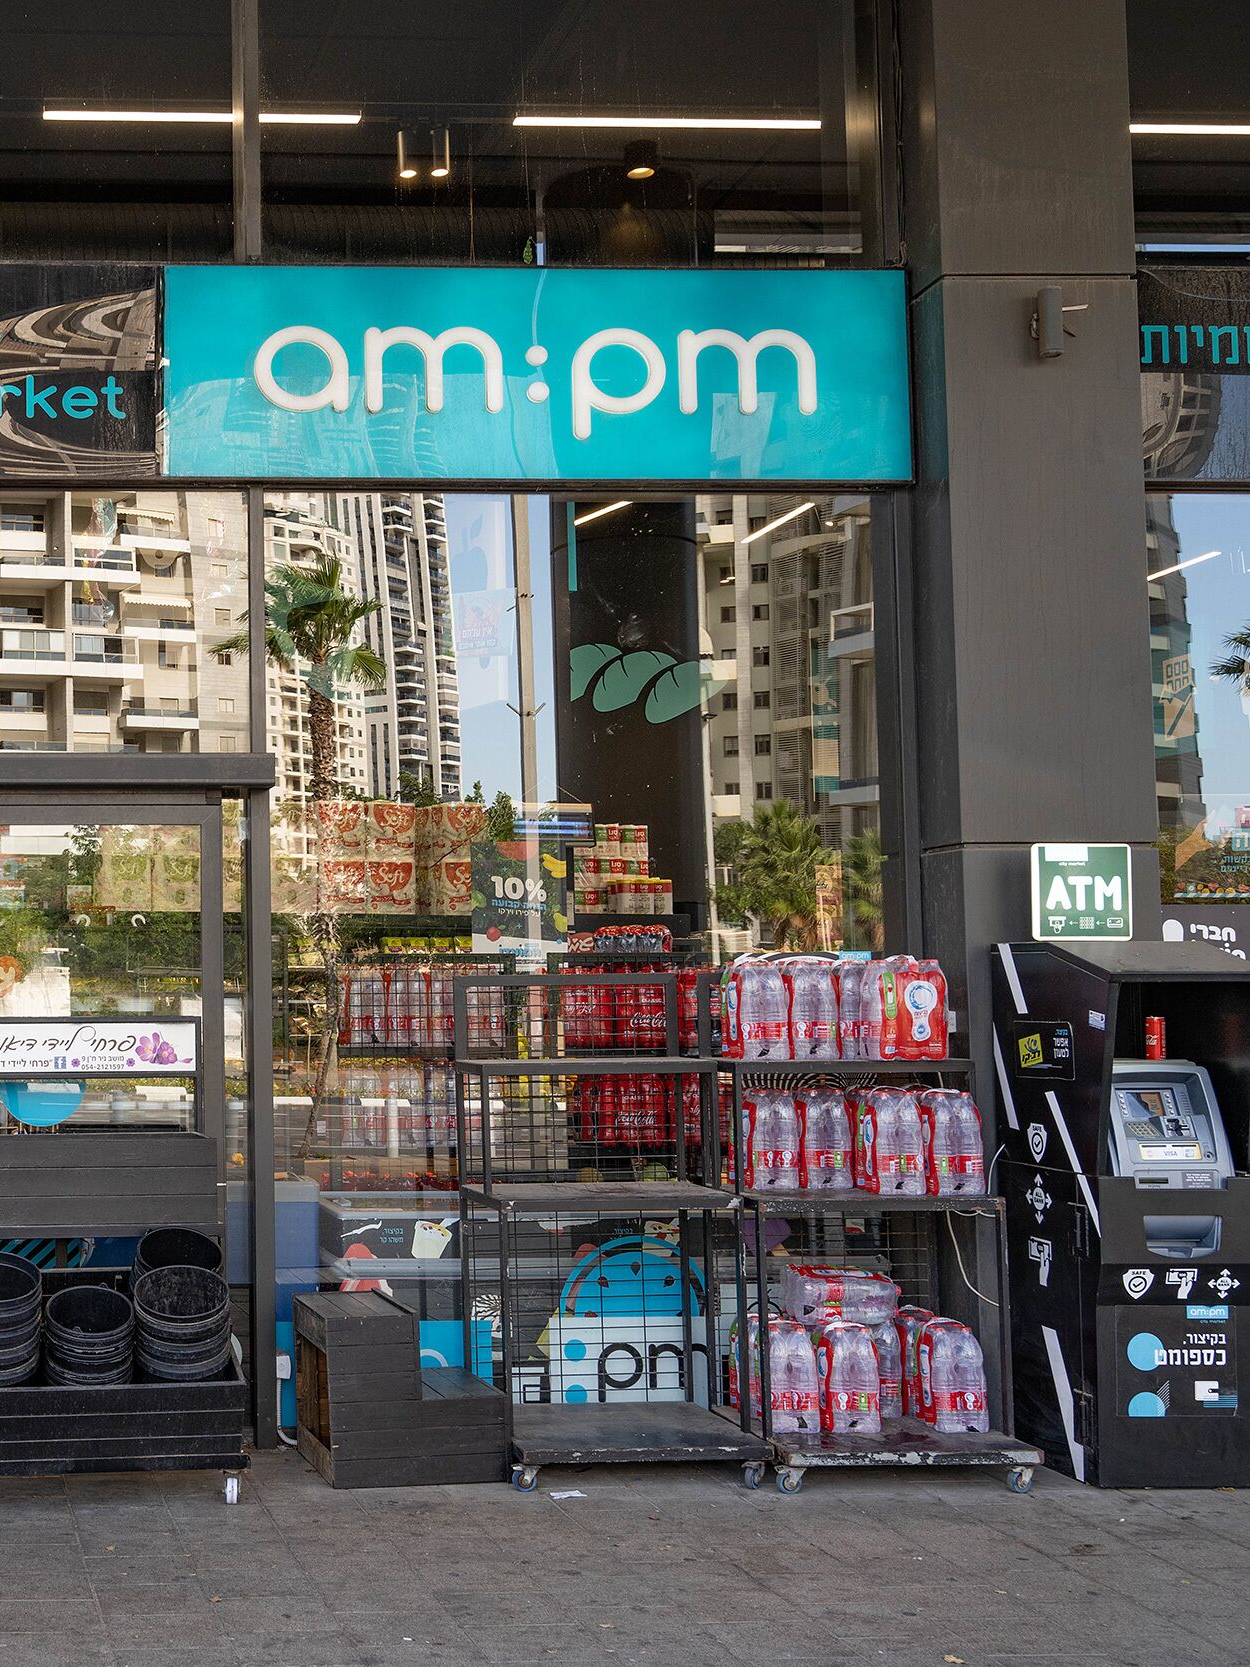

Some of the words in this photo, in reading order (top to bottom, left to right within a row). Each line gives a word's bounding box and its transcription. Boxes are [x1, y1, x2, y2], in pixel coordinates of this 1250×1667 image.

[1141, 325, 1250, 365] מיות
[254, 326, 817, 440] am:pm
[491, 875, 547, 902] 10%
[1046, 875, 1122, 911] ATM
[1190, 923, 1236, 942] חברי
[42, 1025, 96, 1051] ליידי
[91, 1035, 137, 1052] פרחי
[8, 1058, 27, 1067] ליידי
[1190, 1307, 1225, 1316] am:pm
[1154, 1349, 1227, 1366] כספומט
